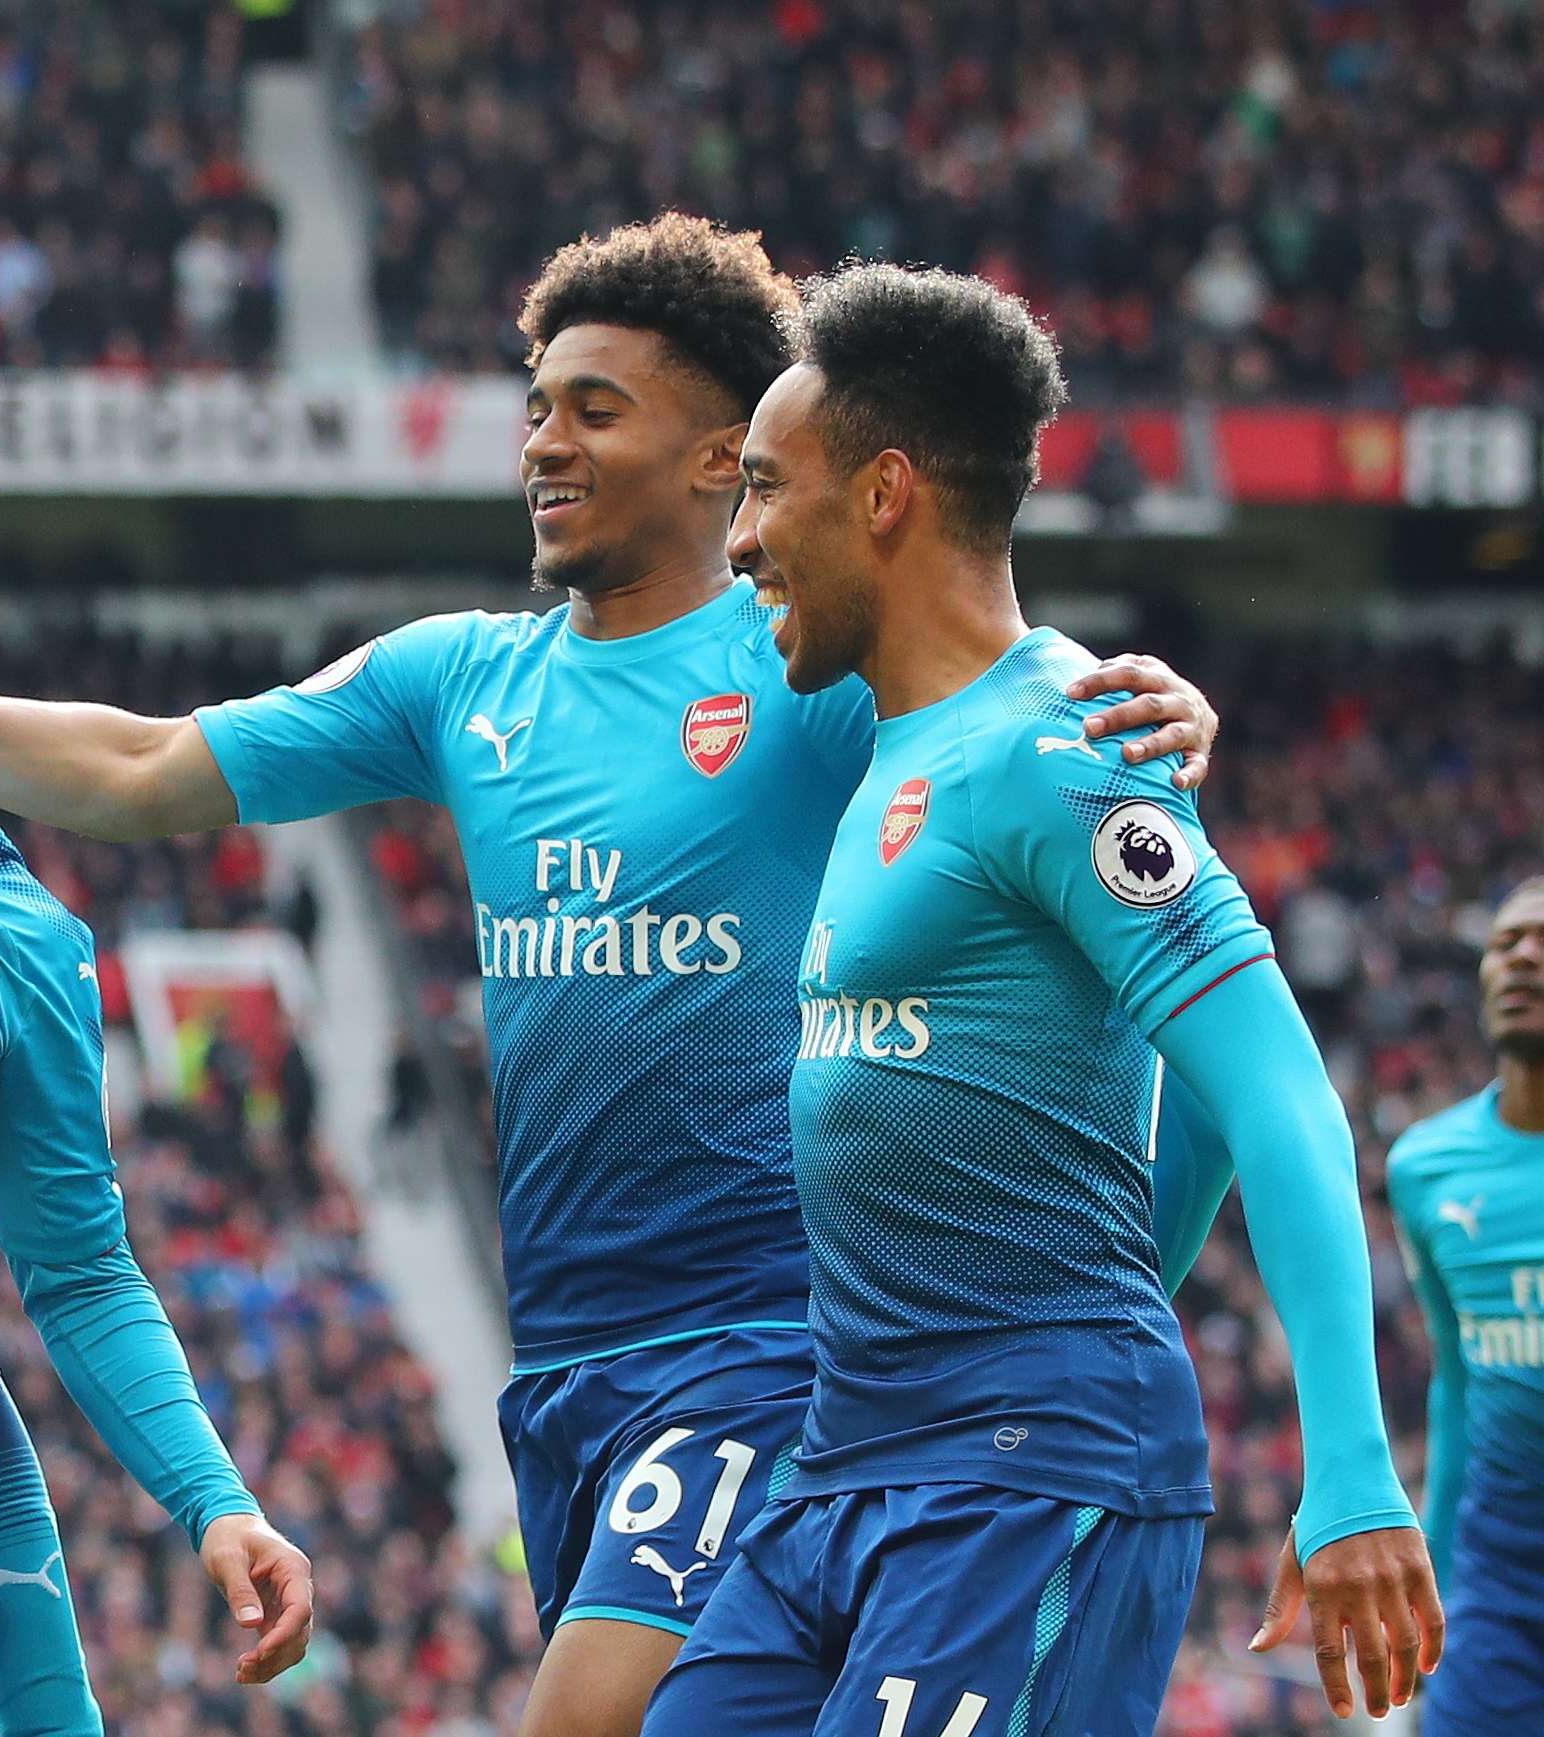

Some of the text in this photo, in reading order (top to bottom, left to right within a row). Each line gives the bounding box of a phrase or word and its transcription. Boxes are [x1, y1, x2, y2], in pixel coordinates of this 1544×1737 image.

[691, 702, 743, 723] Arsenal
[535, 838, 622, 902] Fly
[1111, 874, 1177, 899] Premier League
[479, 897, 743, 979] Emirates
[608, 1427, 756, 1560] 61
